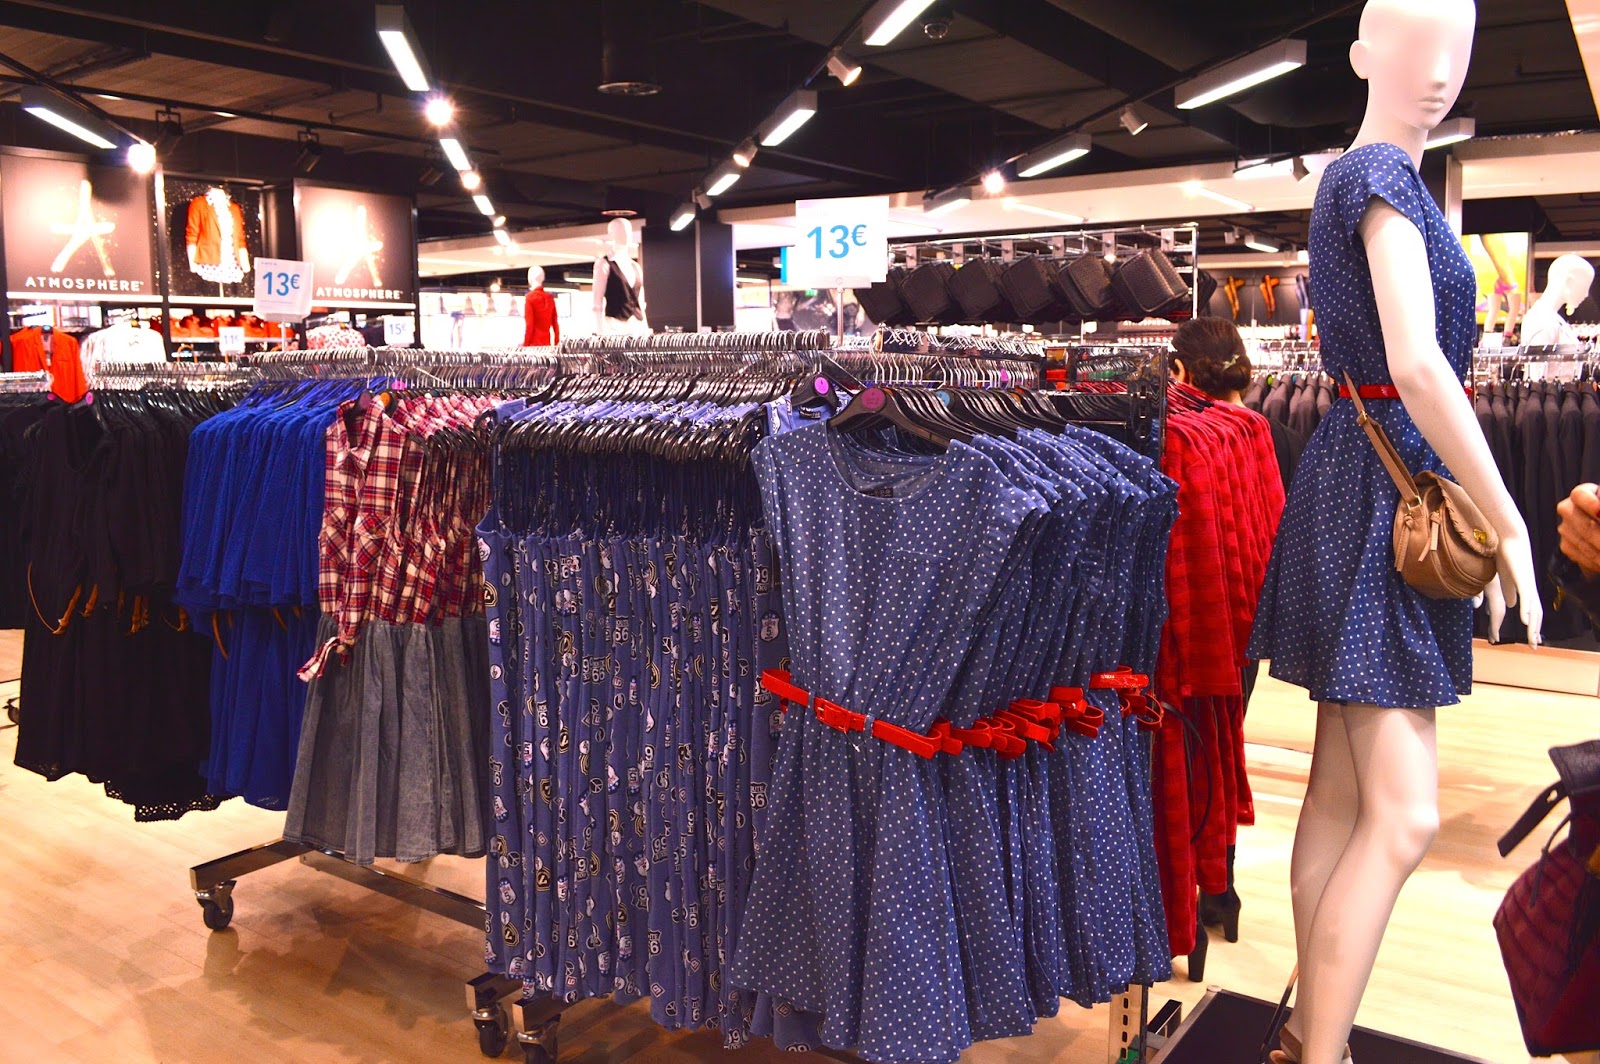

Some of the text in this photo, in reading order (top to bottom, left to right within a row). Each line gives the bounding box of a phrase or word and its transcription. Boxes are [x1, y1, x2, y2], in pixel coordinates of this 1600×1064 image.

[806, 224, 867, 259] 13€
[25, 276, 141, 291] ATMOSPHERE
[262, 271, 300, 296] 13€
[316, 287, 400, 299] ATMOSPHERE
